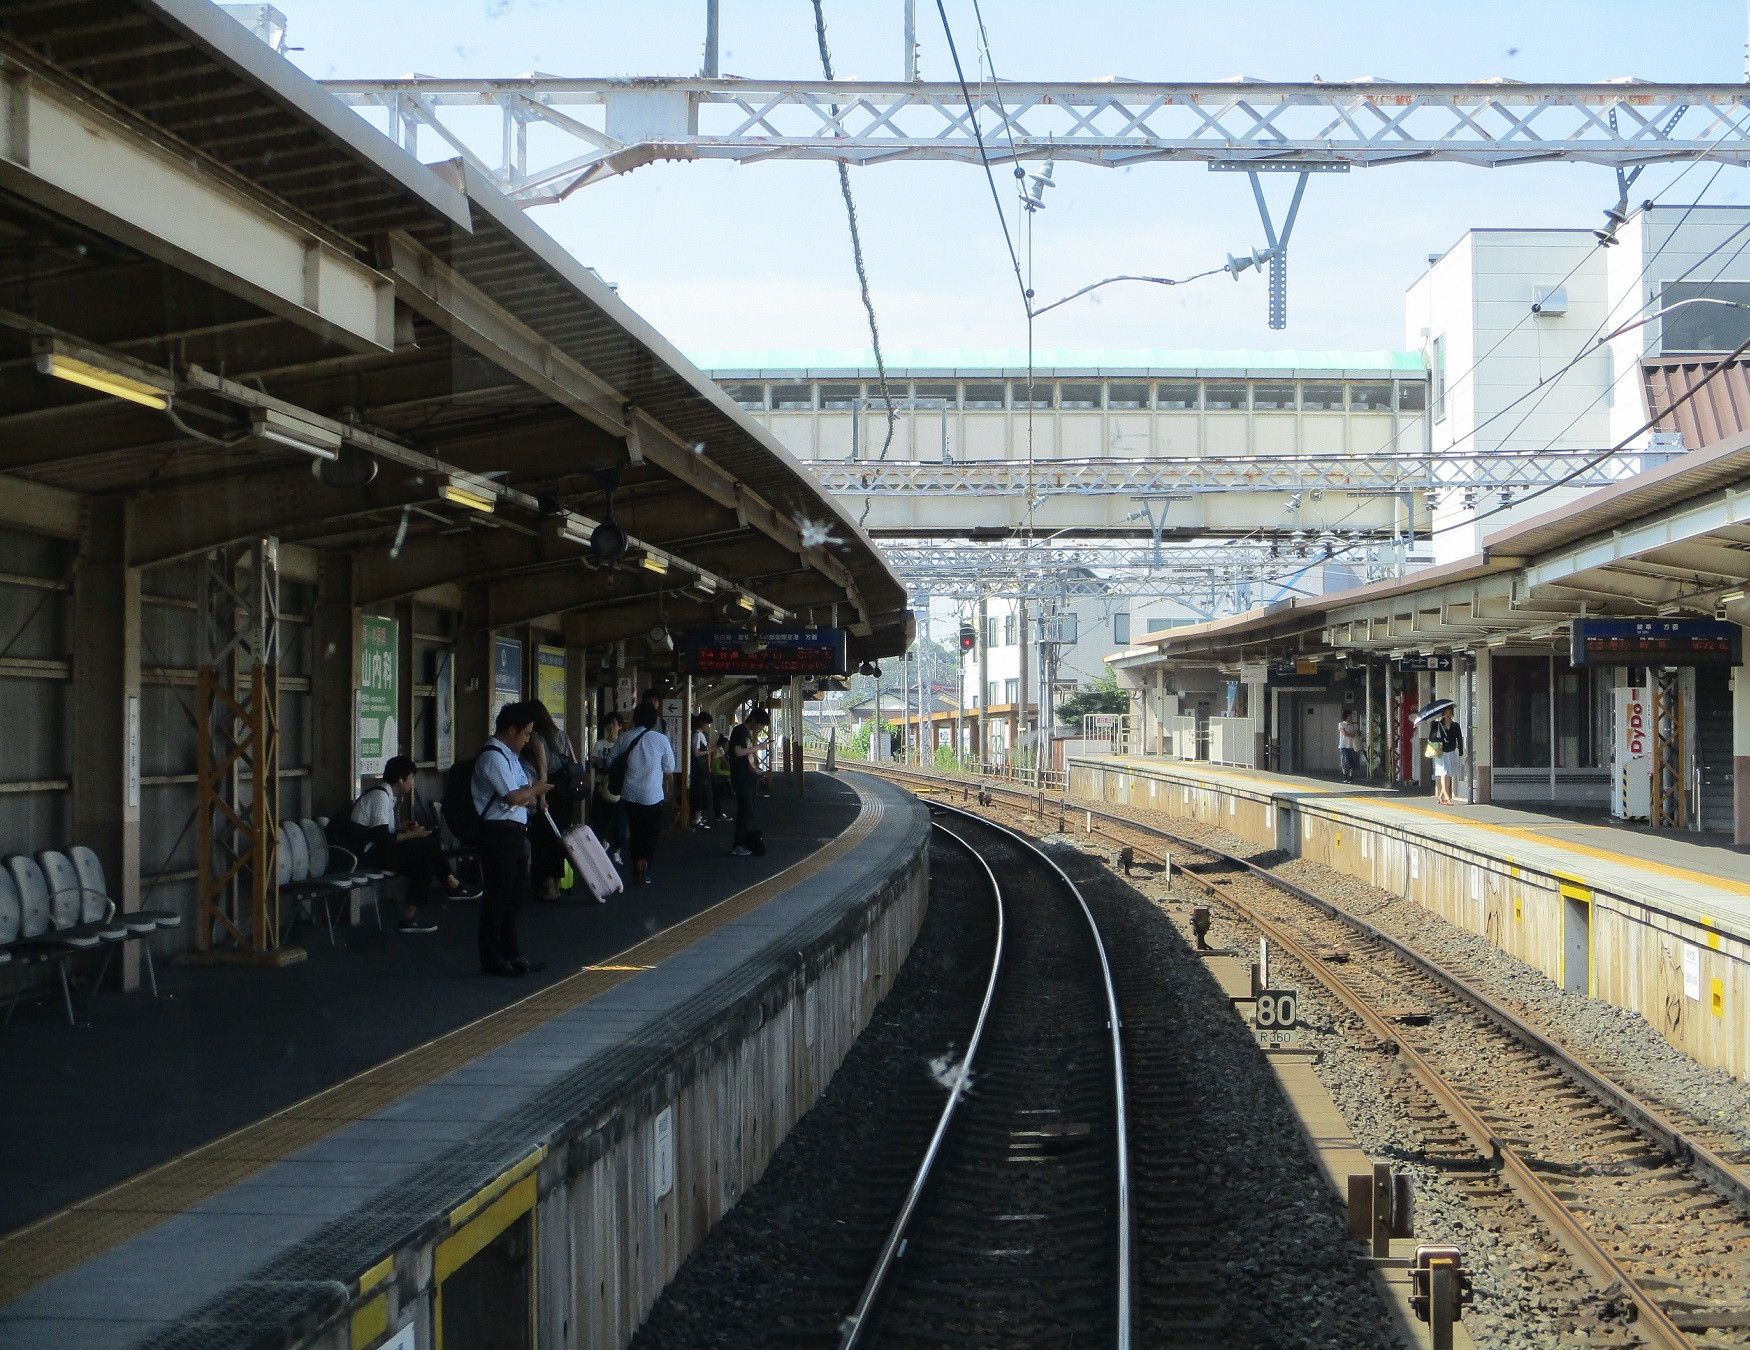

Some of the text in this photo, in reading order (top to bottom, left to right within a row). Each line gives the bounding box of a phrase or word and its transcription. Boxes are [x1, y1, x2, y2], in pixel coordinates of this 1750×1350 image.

[1663, 623, 1679, 631] 方面
[1630, 703, 1646, 753] DyDo
[1257, 995, 1296, 1026] 80
